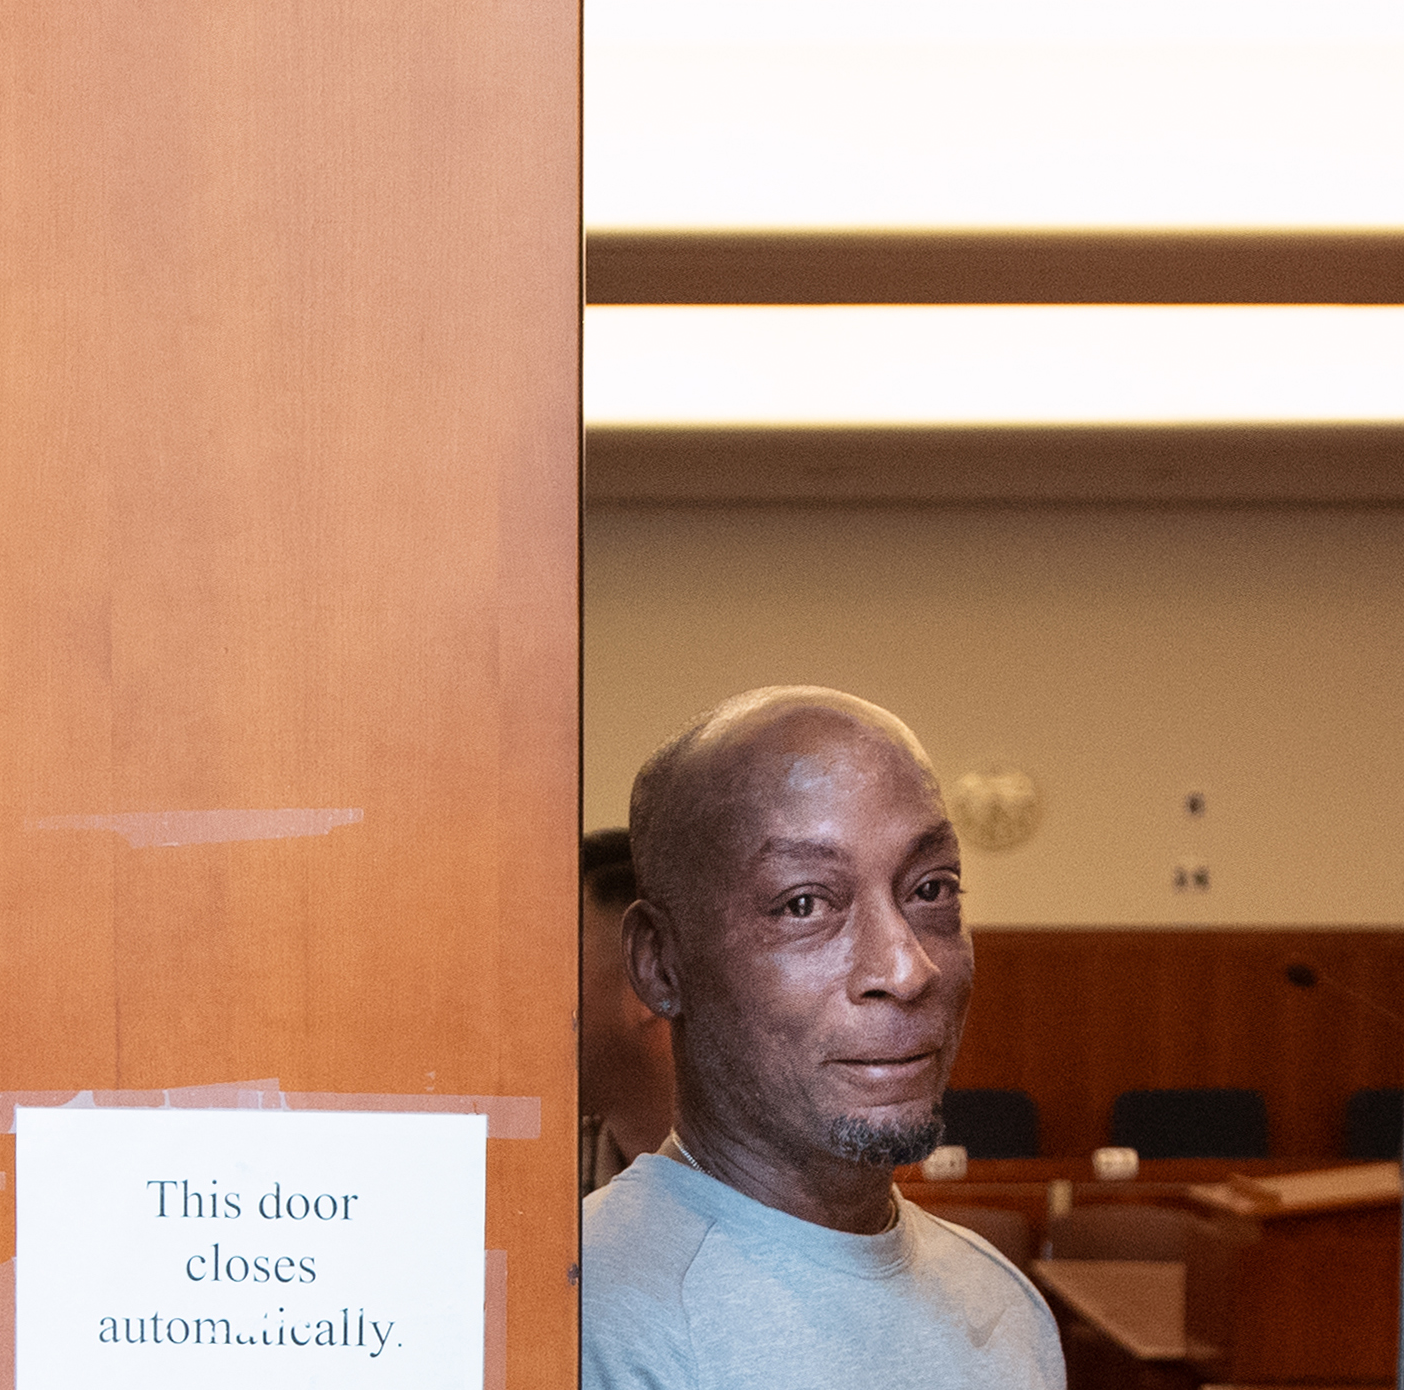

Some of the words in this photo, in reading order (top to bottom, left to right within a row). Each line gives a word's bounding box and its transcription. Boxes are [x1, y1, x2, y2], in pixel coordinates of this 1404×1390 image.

[146, 1178, 242, 1220] This
[258, 1181, 359, 1221] door
[185, 1242, 317, 1284] closes
